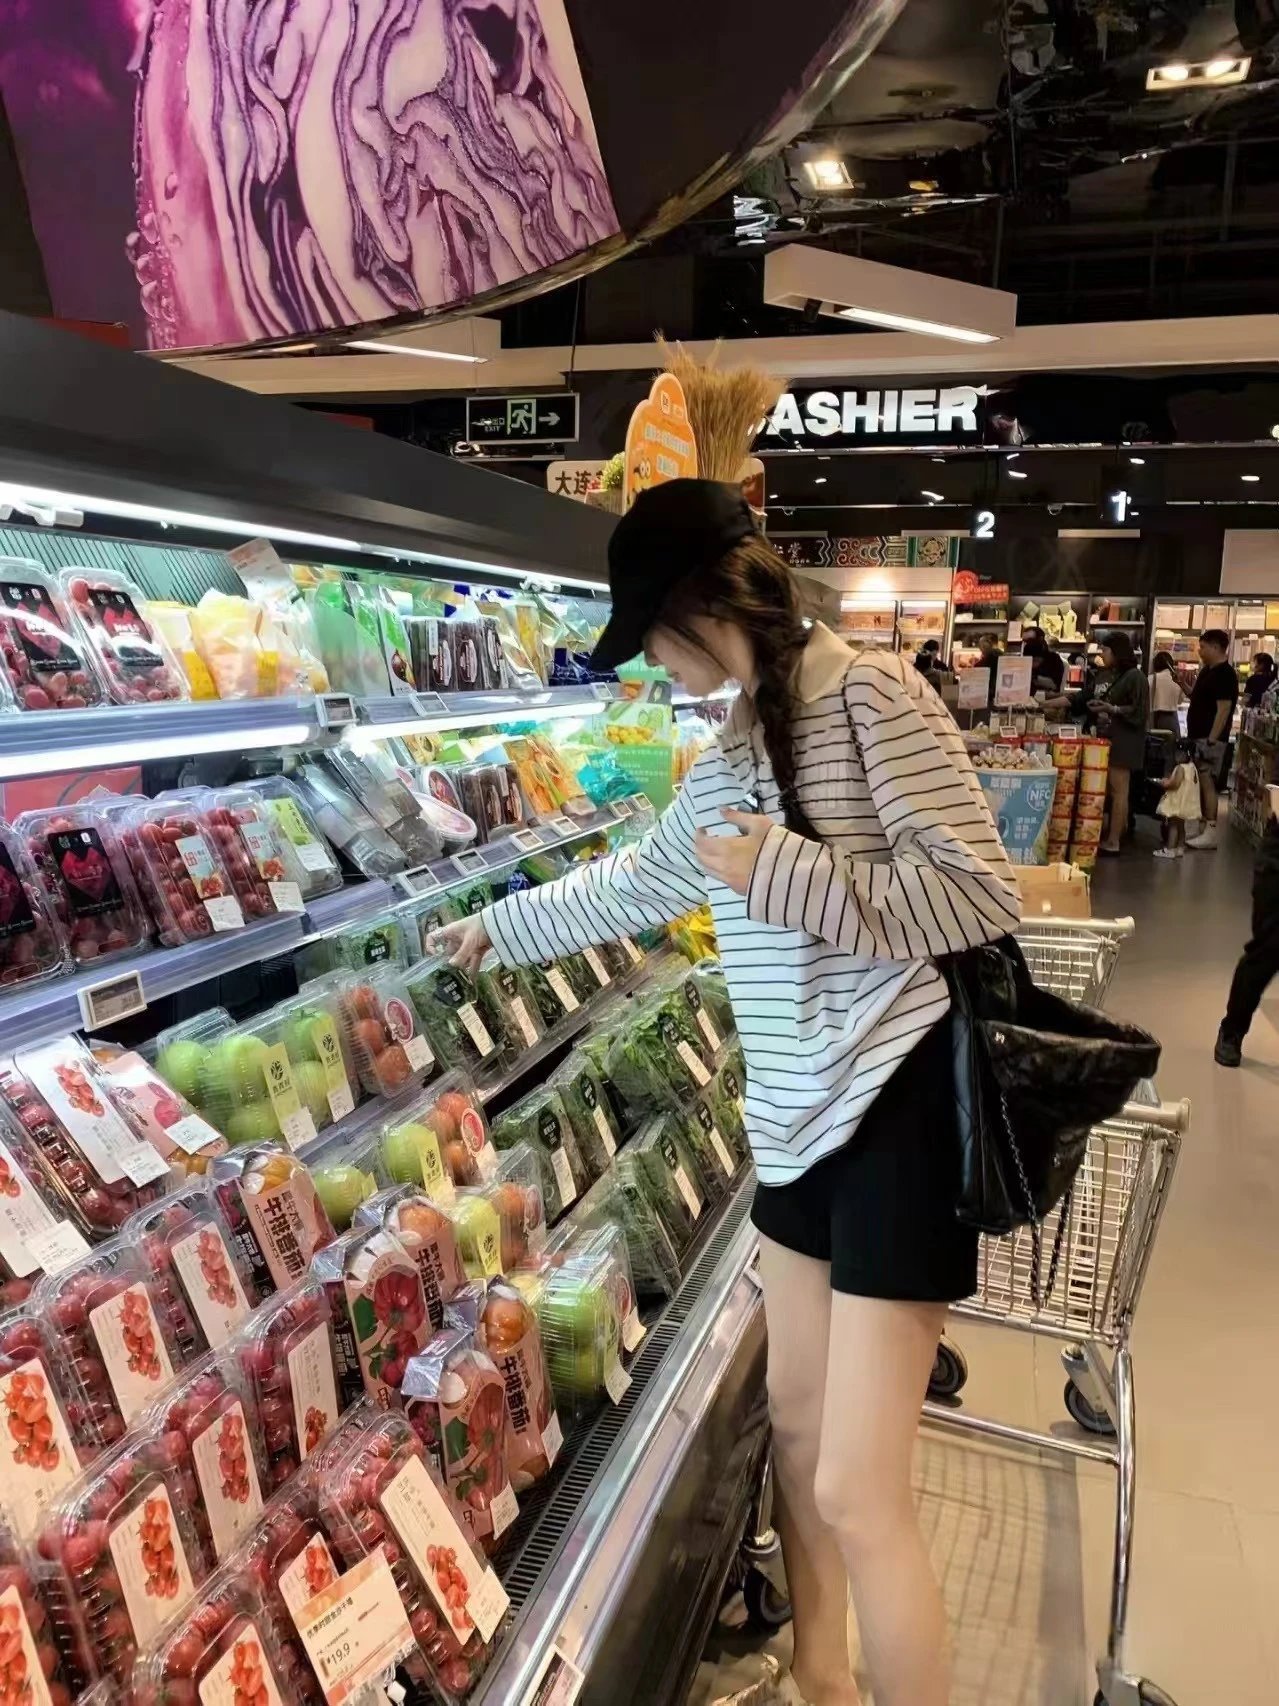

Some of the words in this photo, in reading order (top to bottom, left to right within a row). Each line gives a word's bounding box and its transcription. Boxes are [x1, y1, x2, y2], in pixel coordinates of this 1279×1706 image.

[747, 386, 978, 436] ASHIER
[1111, 491, 1127, 522] 1
[976, 511, 995, 538] 2
[1029, 789, 1051, 801] NFC
